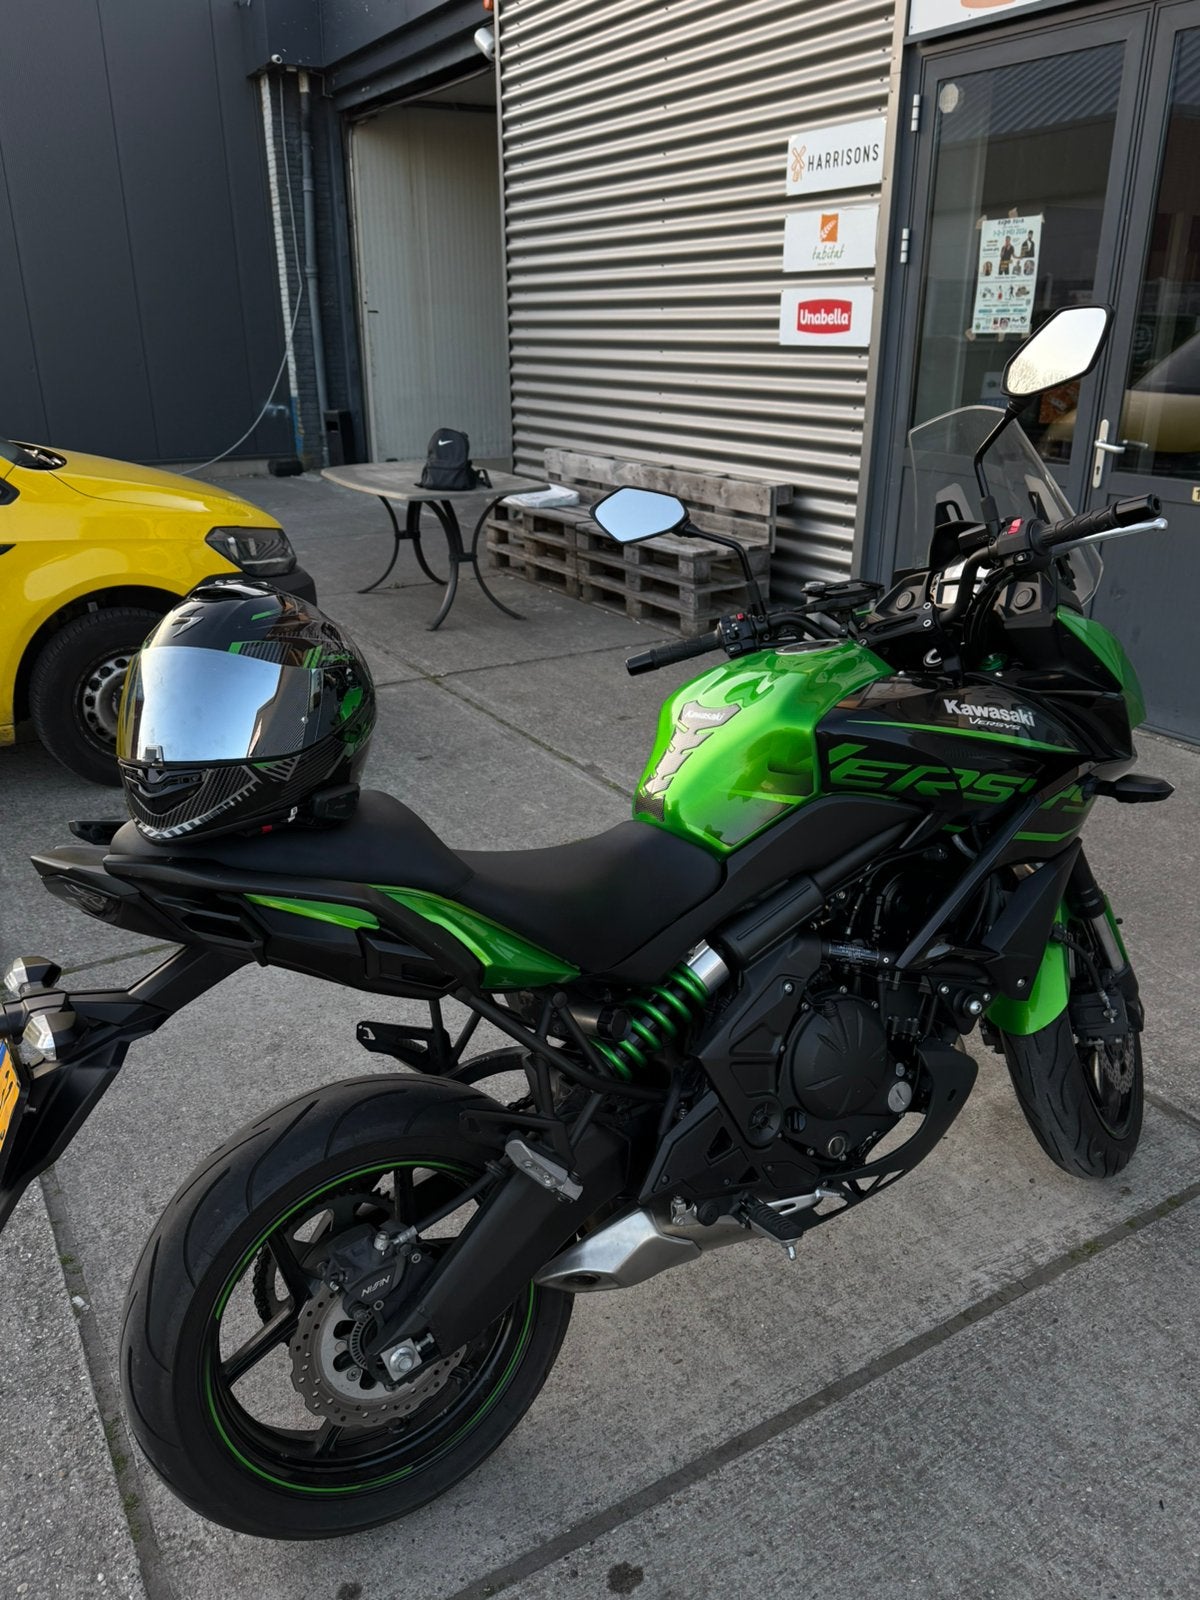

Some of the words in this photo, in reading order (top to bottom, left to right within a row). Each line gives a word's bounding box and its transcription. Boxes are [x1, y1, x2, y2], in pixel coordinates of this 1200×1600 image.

[807, 143, 879, 172] HARRISONS
[800, 308, 849, 325] Unabella
[943, 699, 1035, 727] Kawasaki
[969, 717, 1021, 731] VERSYS
